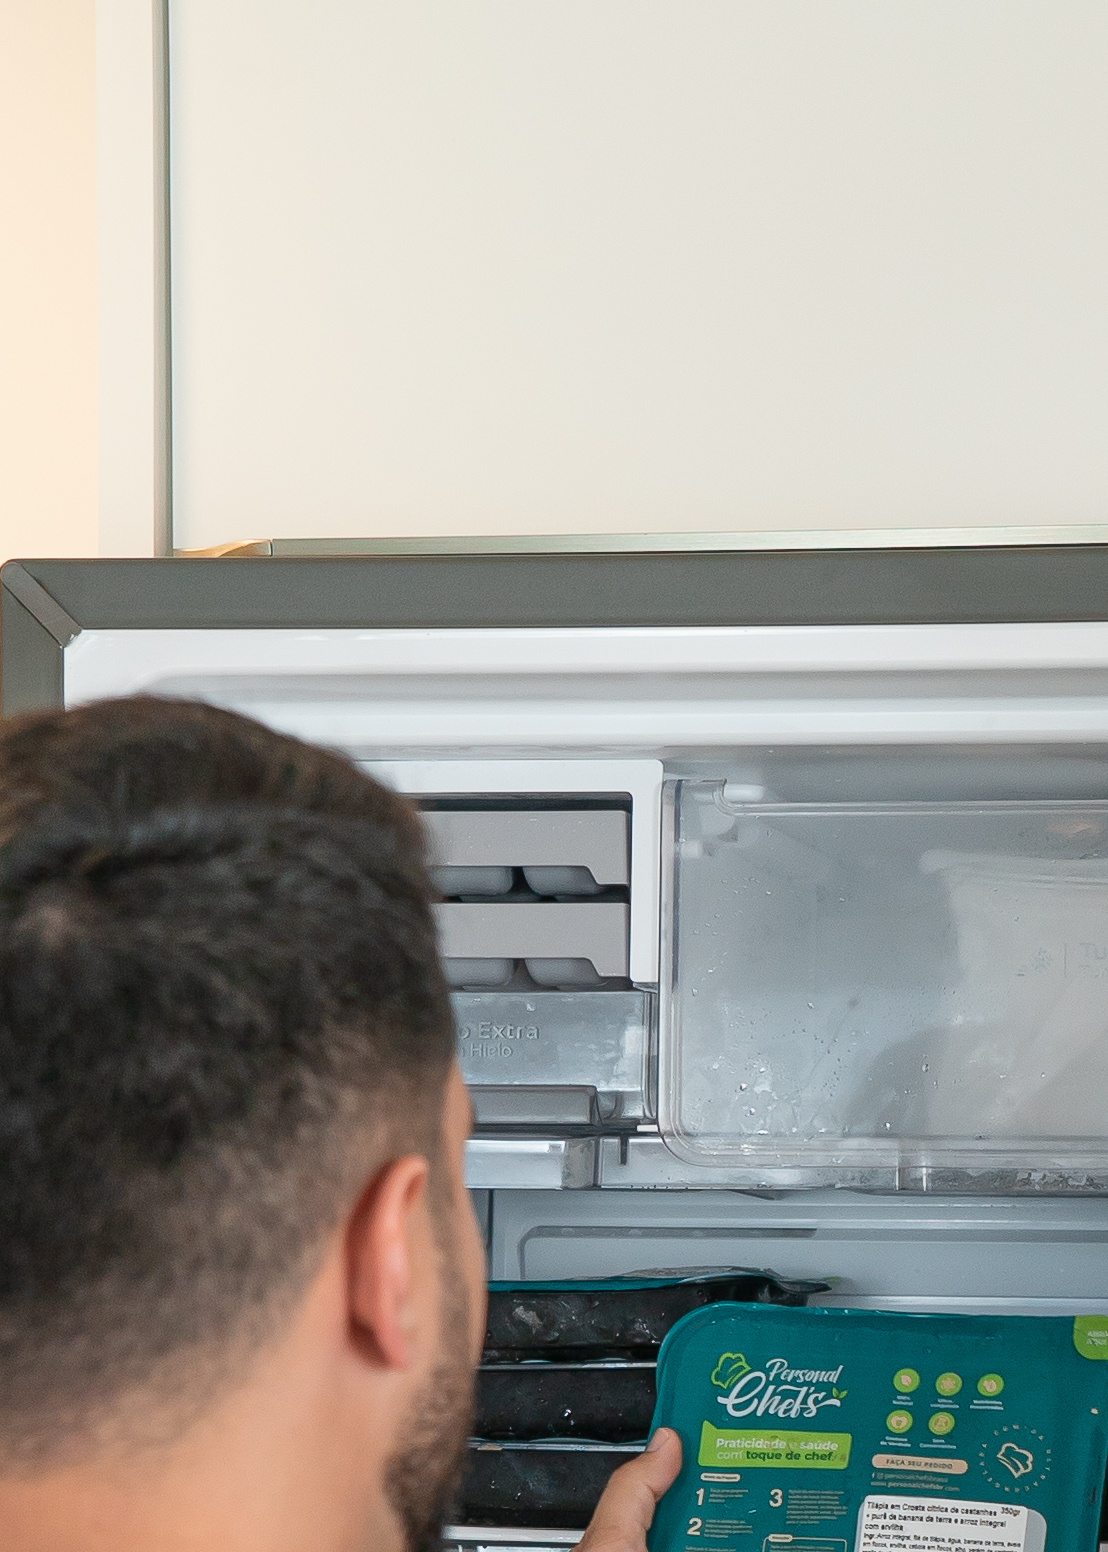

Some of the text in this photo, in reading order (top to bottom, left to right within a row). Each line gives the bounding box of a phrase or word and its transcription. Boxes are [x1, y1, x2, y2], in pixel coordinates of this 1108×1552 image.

[479, 1021, 539, 1039] Extra
[470, 1043, 513, 1057] Hielo
[766, 1358, 844, 1383] Personal
[716, 1438, 786, 1449] Praticidade
[800, 1440, 838, 1451] saúde
[717, 1451, 742, 1459] com
[746, 1451, 782, 1461] toque
[786, 1451, 800, 1460] de
[886, 1459, 906, 1468] FAÇA
[696, 1488, 705, 1506] 1
[769, 1488, 783, 1508] 3
[902, 1503, 925, 1511] Crosta
[961, 1508, 997, 1516] castanhas
[1001, 1507, 1020, 1517] 350gr
[687, 1517, 702, 1536] 2
[881, 1523, 903, 1531] ervilha
[898, 1514, 923, 1522] banana
[979, 1518, 1006, 1528] integral
